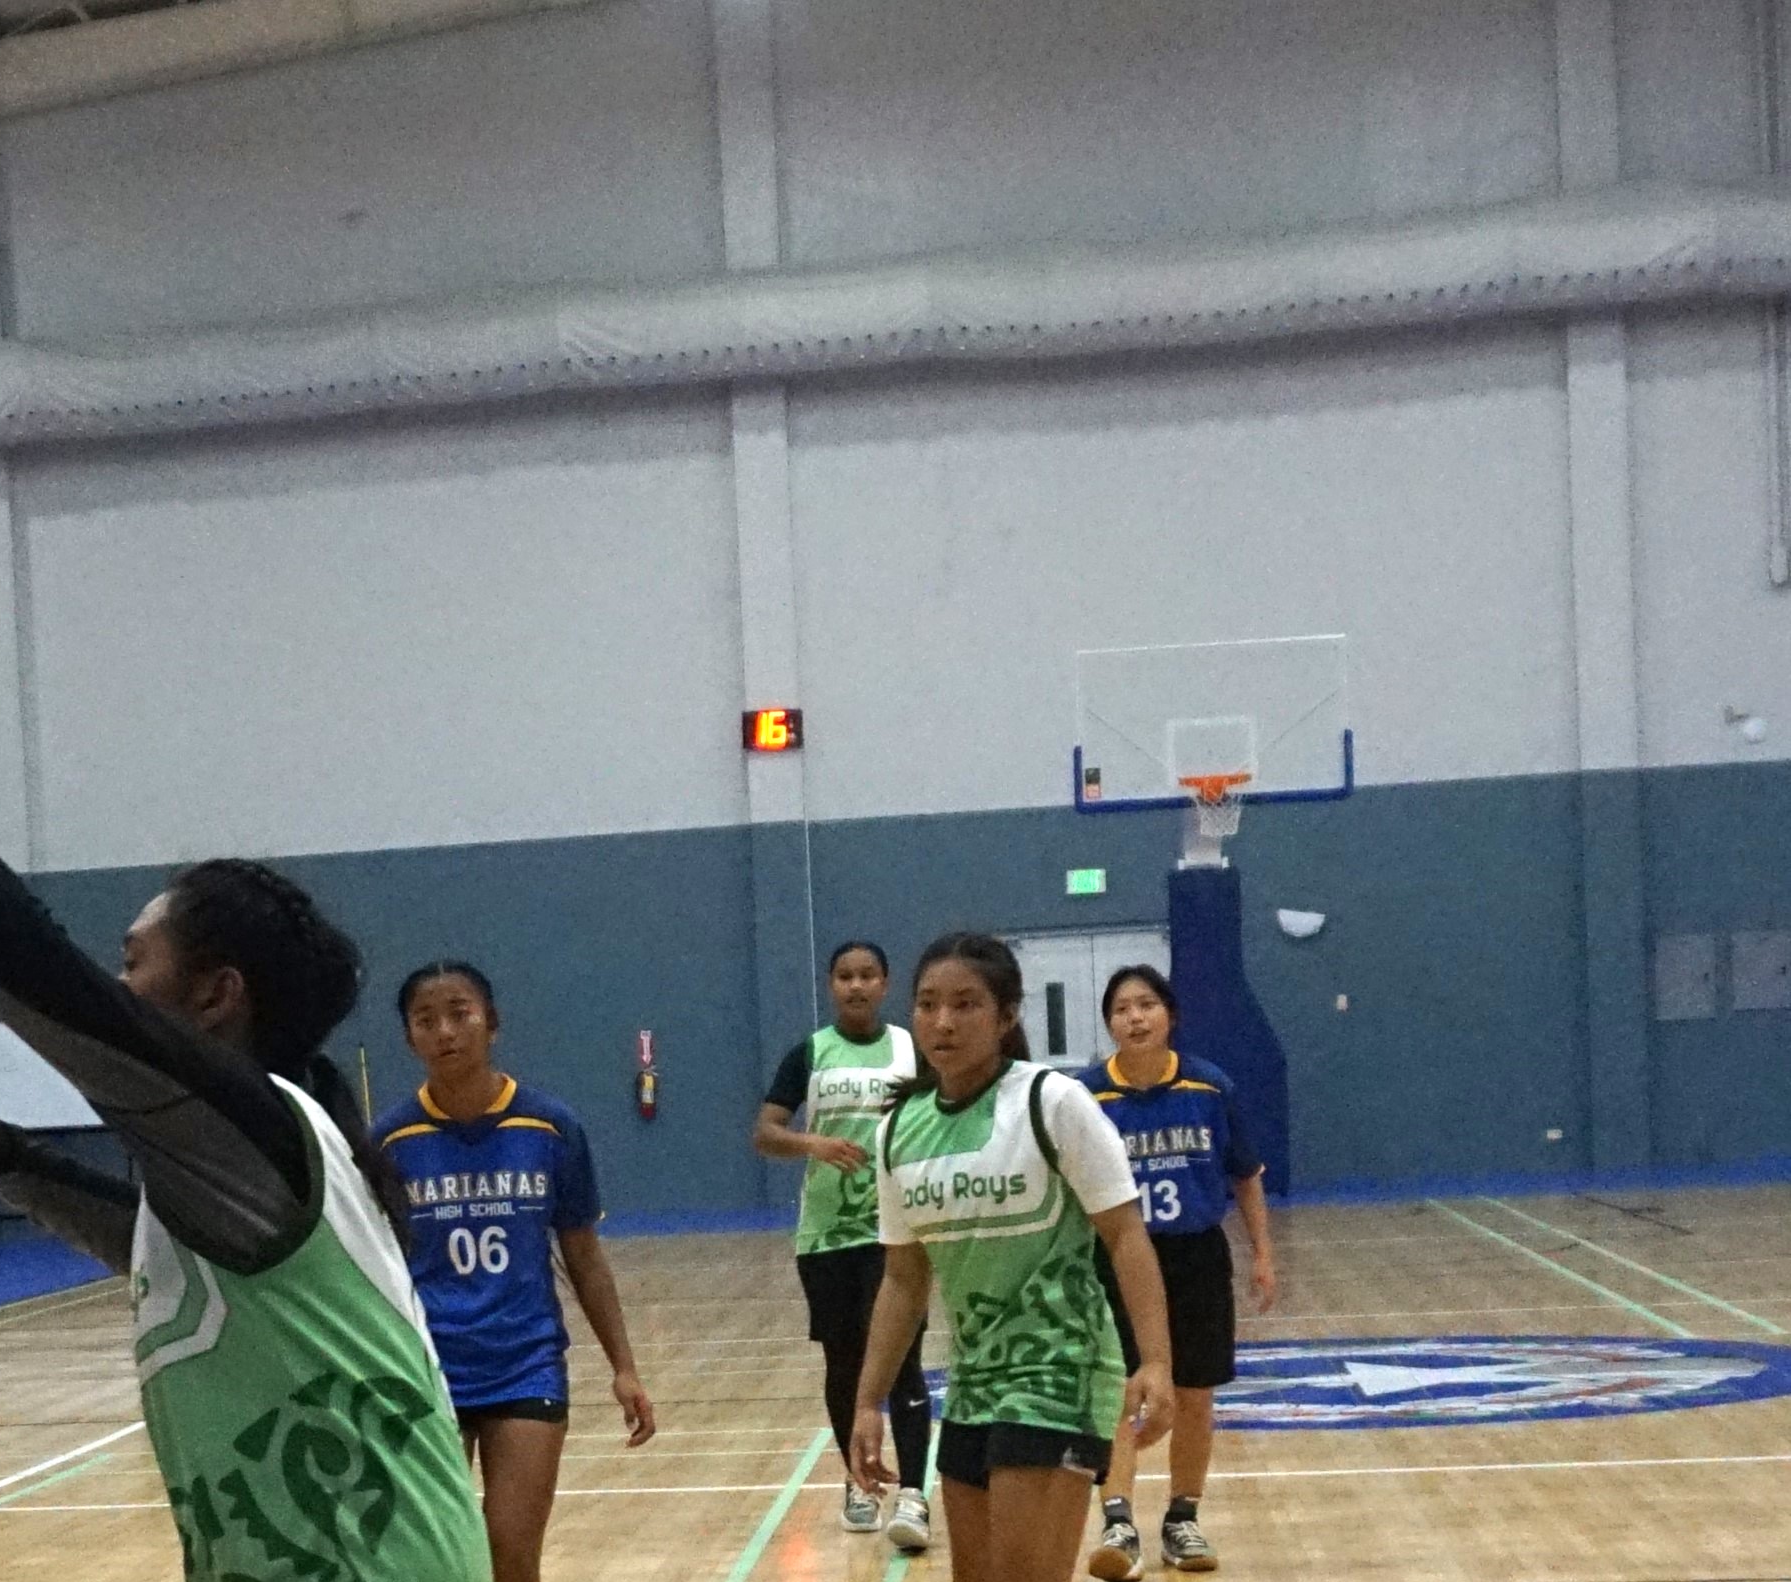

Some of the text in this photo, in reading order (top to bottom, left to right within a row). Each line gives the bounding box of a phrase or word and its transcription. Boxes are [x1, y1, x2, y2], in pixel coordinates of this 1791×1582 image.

[757, 709, 787, 747] 16
[817, 1078, 862, 1099] Lady
[902, 1172, 1027, 1210] ady Rays
[1138, 1179, 1182, 1223] 13
[435, 1201, 516, 1220] HIGH SCHOOL
[448, 1225, 510, 1275] 06
